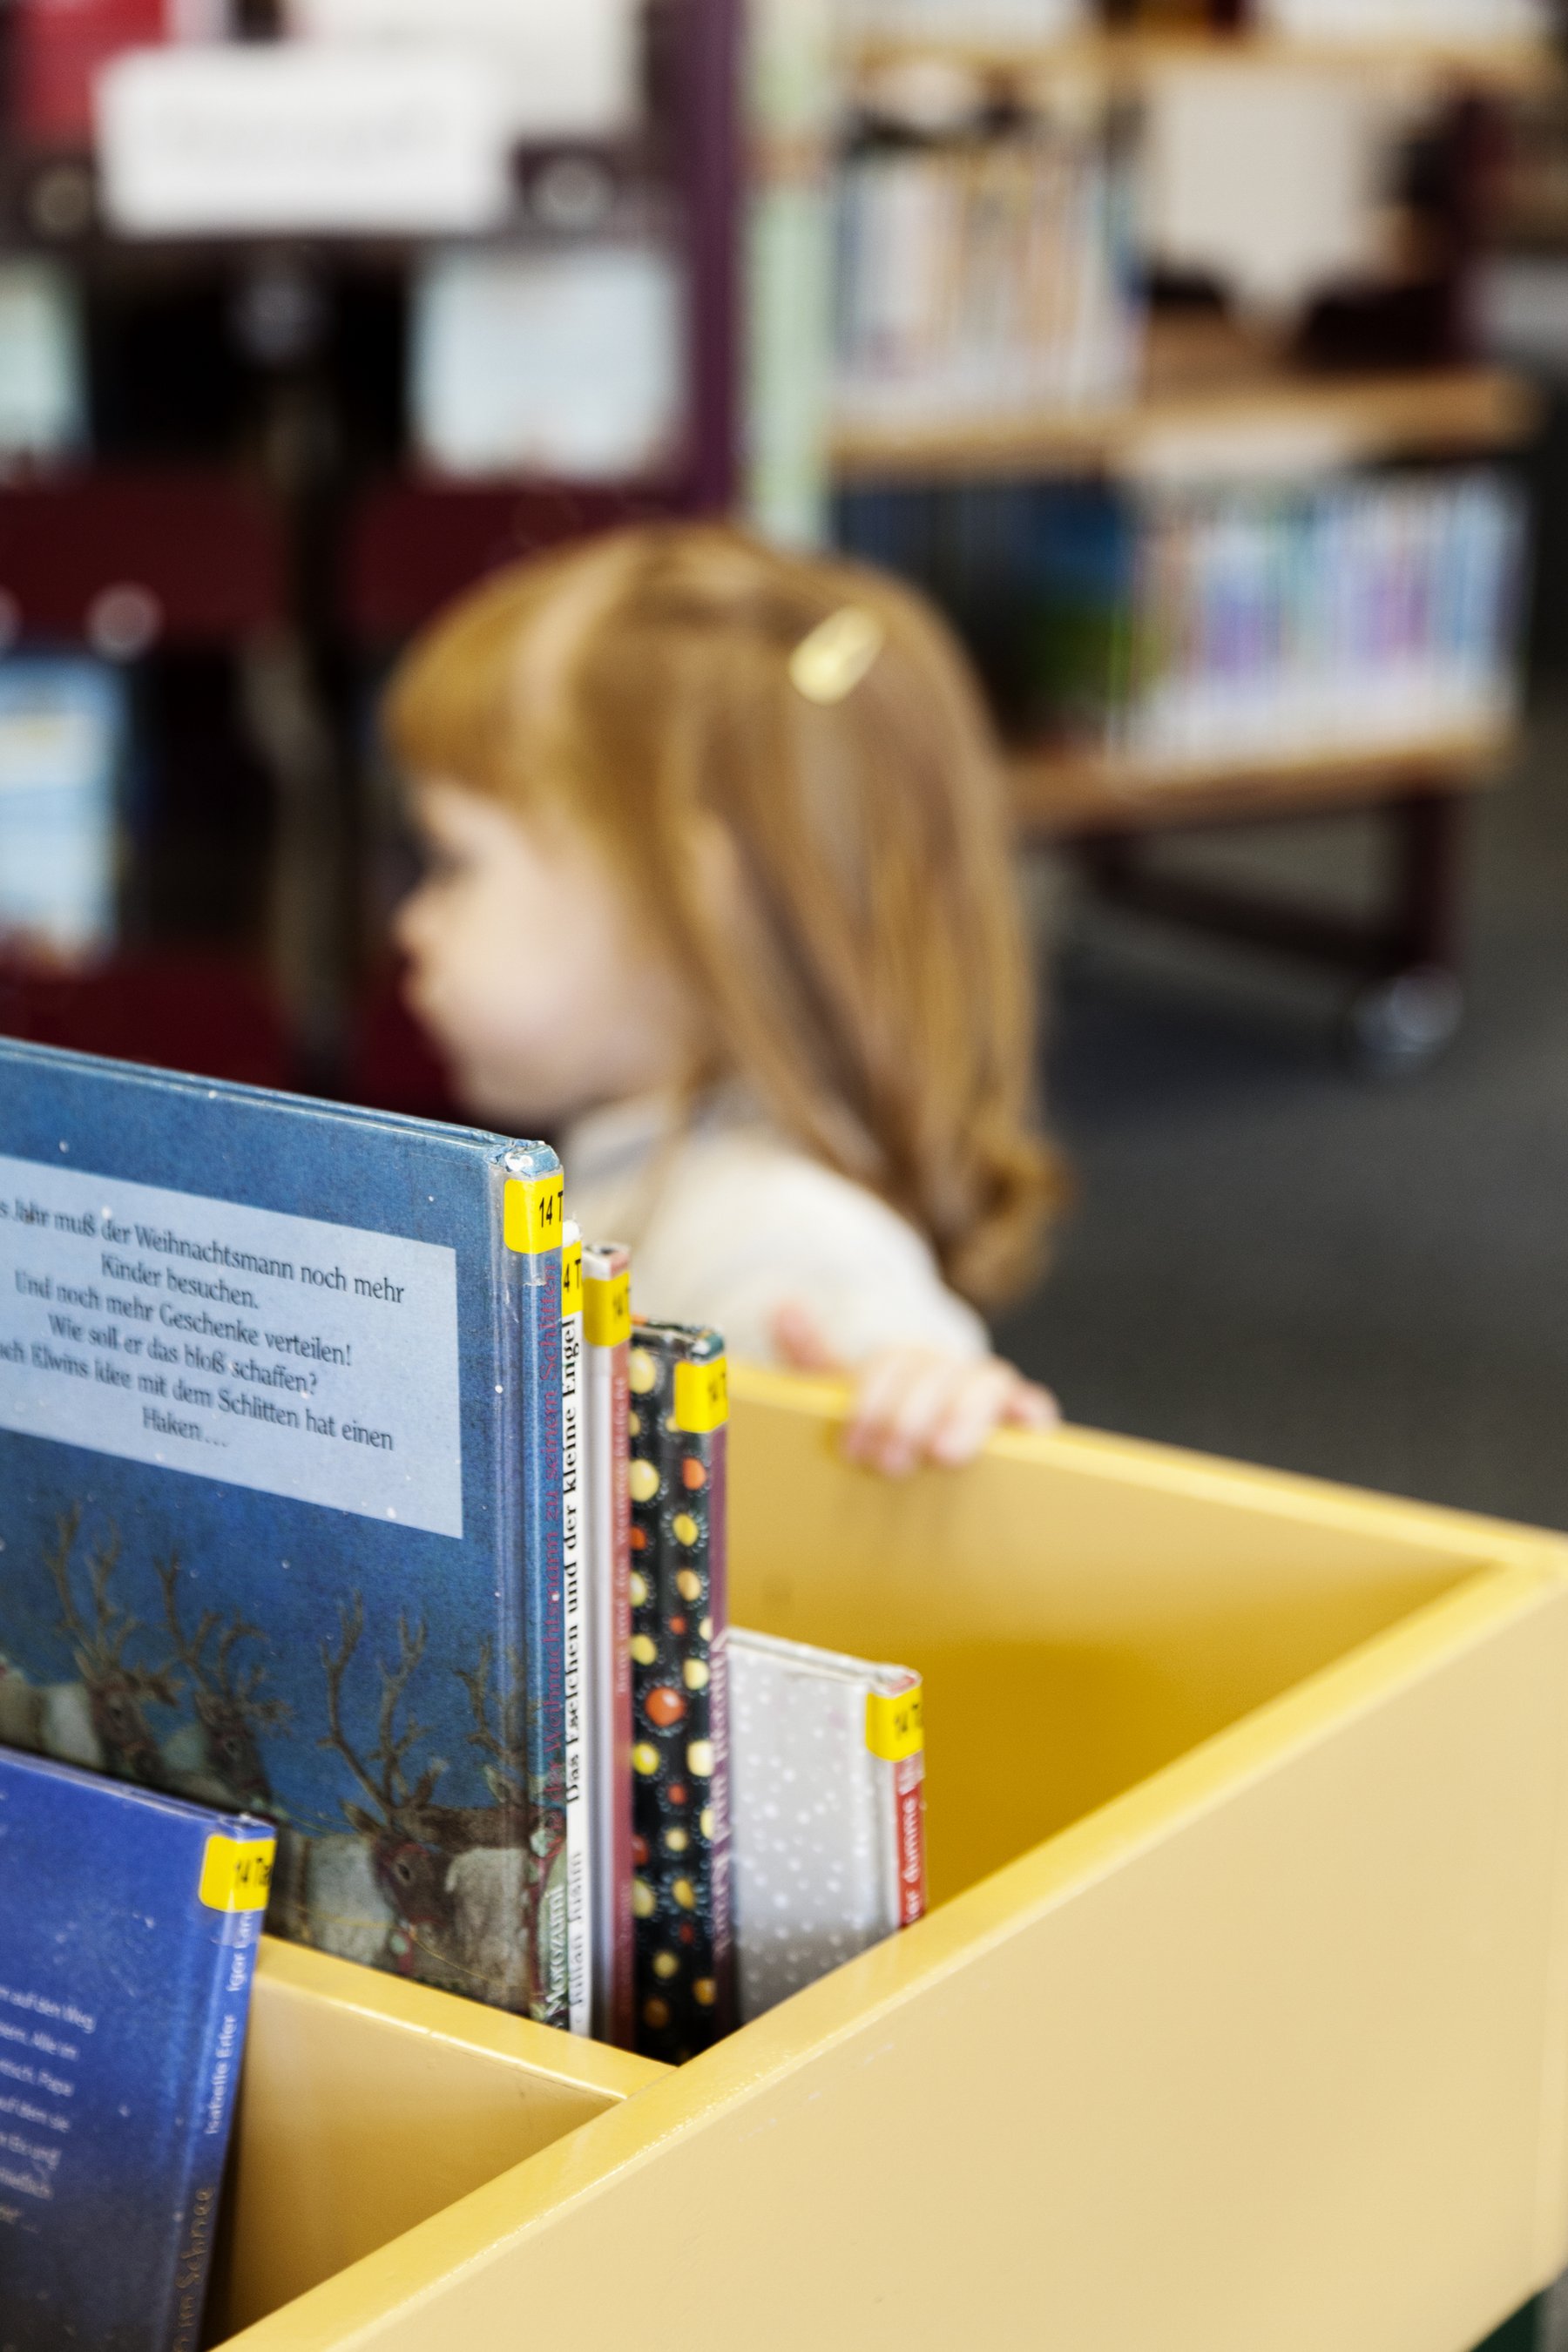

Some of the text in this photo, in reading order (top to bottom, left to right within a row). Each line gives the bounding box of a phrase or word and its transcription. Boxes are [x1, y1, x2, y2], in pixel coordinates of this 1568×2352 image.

[13, 1197, 50, 1228] Jahr
[53, 1212, 96, 1239] muß
[101, 1219, 132, 1245] der
[134, 1223, 294, 1281] Weihnachtsmann
[301, 1266, 347, 1292] noch
[354, 1276, 405, 1303] mehr
[539, 1195, 552, 1227] 14
[14, 1269, 351, 1366] Und noch mehr Geschenke verteilen!
[100, 1252, 259, 1308] Kinder besuchen.
[537, 1264, 558, 1382] Schlitten
[30, 1342, 91, 1378] Elwins
[95, 1358, 131, 1389] Idee
[138, 1374, 168, 1397] mit
[172, 1378, 214, 1408] dem
[218, 1389, 300, 1429] Schlitten
[306, 1408, 336, 1437] hat
[342, 1420, 395, 1451] einen
[48, 1313, 317, 1395] Wie soll er das bloß schaffen?
[539, 1389, 558, 1481] seinem
[544, 1489, 558, 1522] zu
[562, 1318, 579, 1804] Das Eselchen und der kleine Engel
[539, 1531, 562, 1754] Weihnachtsmann
[544, 1760, 564, 1801] der
[225, 1952, 248, 1992] Igor
